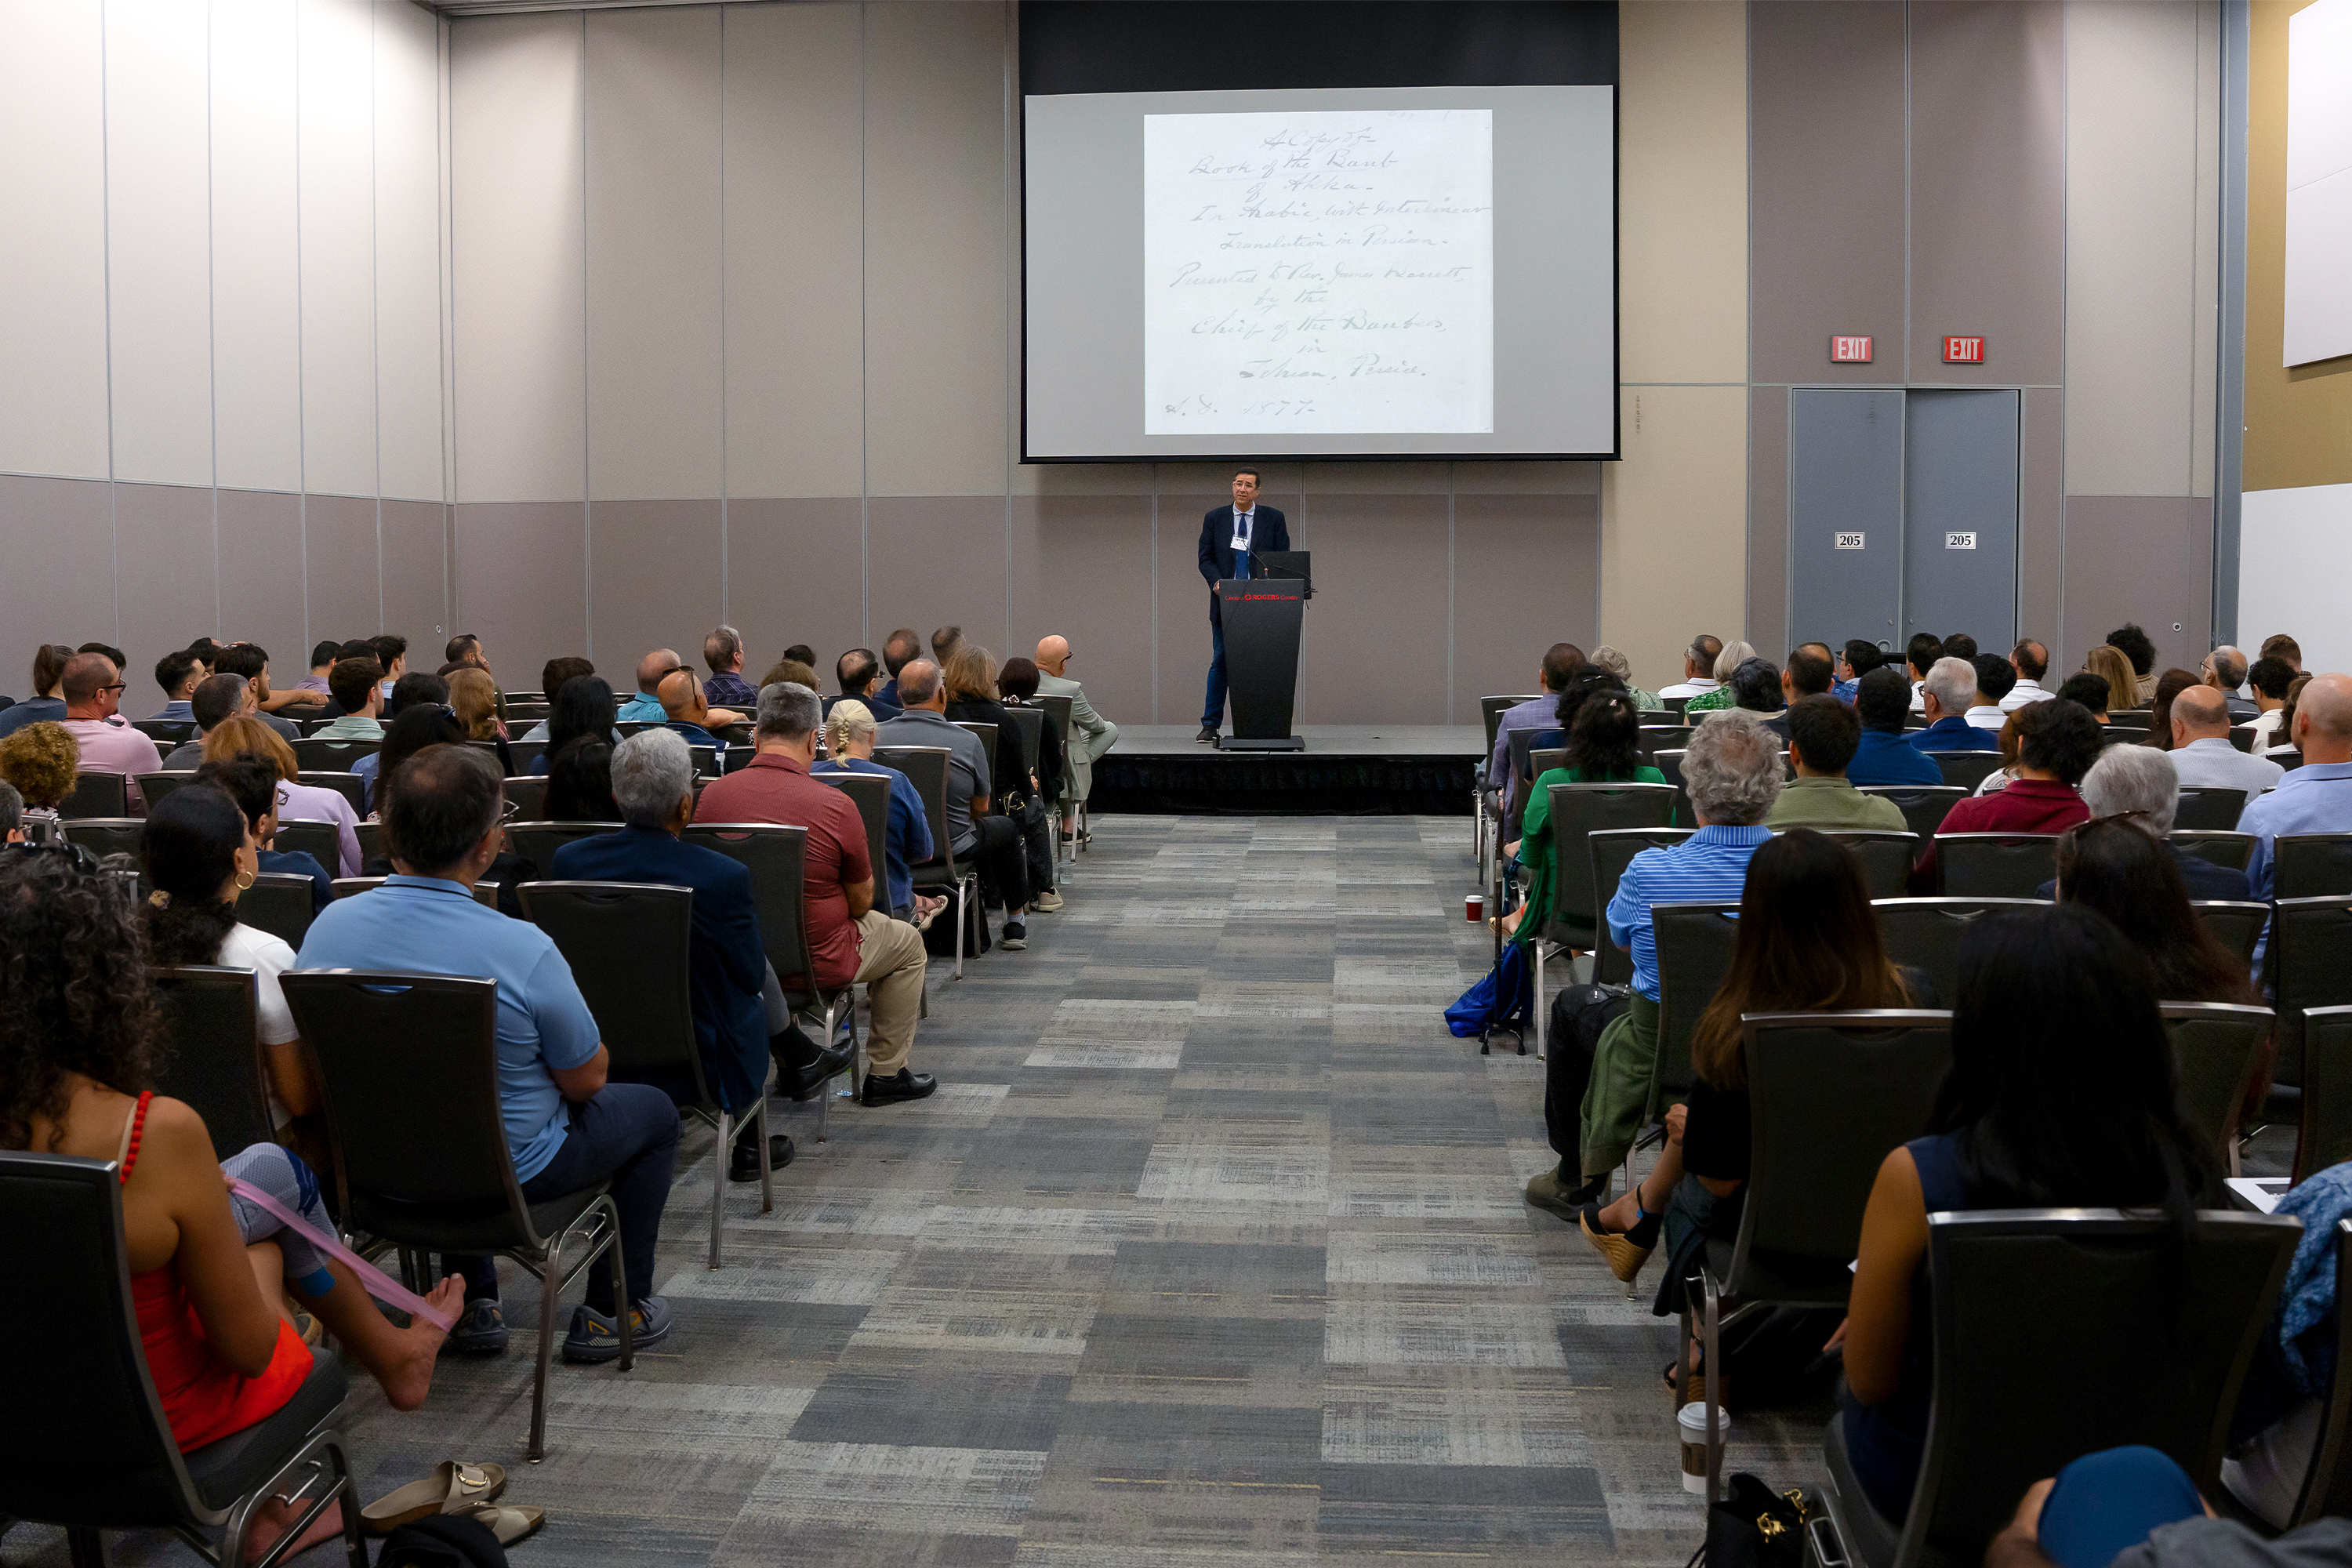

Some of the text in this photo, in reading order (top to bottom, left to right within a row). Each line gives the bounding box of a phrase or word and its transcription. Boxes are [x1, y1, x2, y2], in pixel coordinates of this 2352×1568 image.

[1189, 155, 1256, 174] Book
[1262, 160, 1278, 179] of
[1283, 150, 1311, 169] the
[1245, 182, 1266, 203] of
[1189, 205, 1226, 222] In
[1325, 201, 1369, 216] with
[1220, 231, 1330, 250] Translation
[1334, 232, 1352, 245] in
[1169, 261, 1258, 288] Presented
[1269, 260, 1292, 280] to
[1327, 261, 1374, 285] James
[1254, 285, 1328, 316] by the
[1191, 309, 1263, 339] Chief
[1271, 320, 1290, 342] of
[1297, 308, 1334, 331] the
[1297, 339, 1327, 354] in
[1838, 337, 1867, 359] EXIT
[1950, 338, 1980, 360] EXIT
[1839, 535, 1860, 546] 205
[1950, 535, 1971, 546] 205
